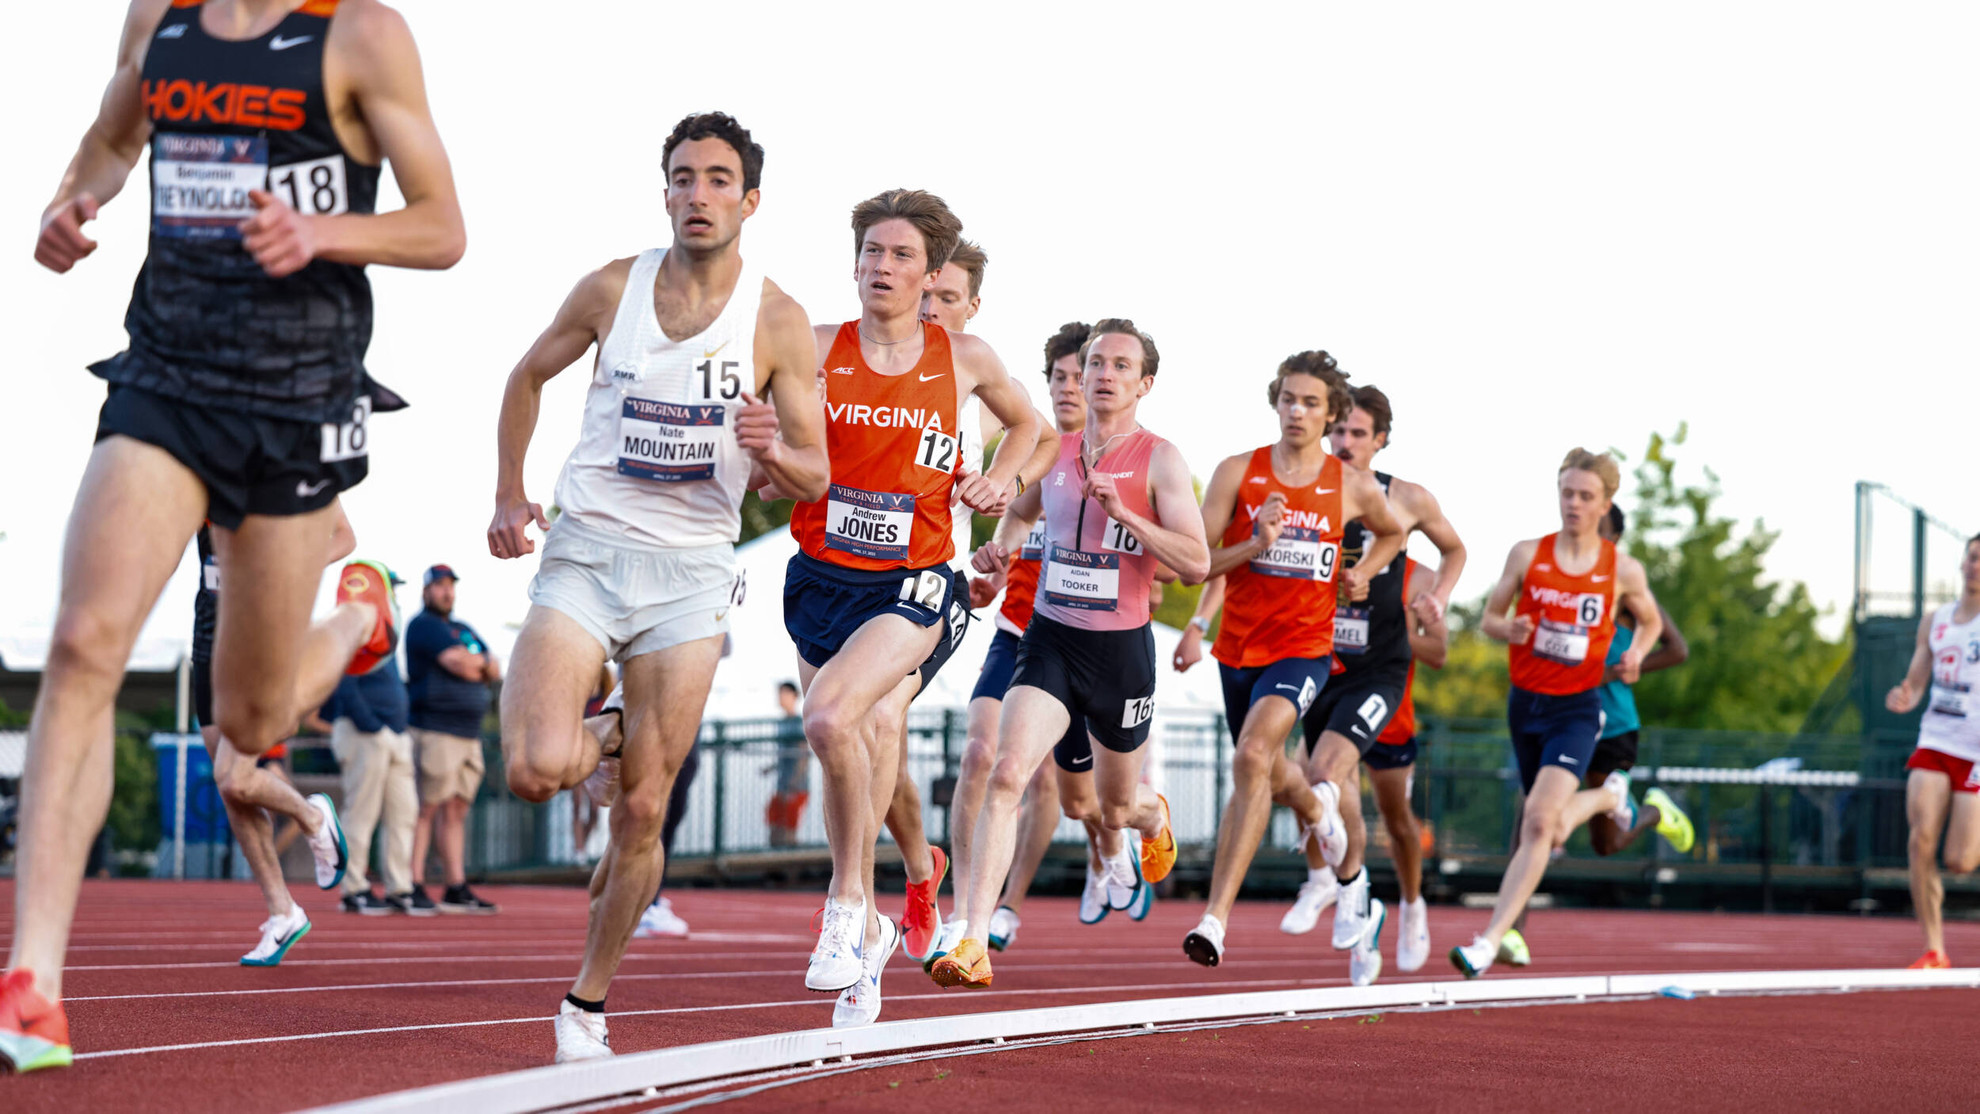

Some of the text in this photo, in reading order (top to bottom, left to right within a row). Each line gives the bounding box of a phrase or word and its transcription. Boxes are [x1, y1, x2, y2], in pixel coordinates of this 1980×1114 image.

[141, 78, 307, 131] HOKIES
[279, 164, 336, 214] 18
[697, 359, 741, 400] 15
[831, 366, 855, 376] ACC
[632, 400, 691, 419] VIRGINIA
[826, 402, 943, 432] VIRGINIA
[659, 425, 685, 439] Nate
[624, 435, 715, 460] MOUNTAIN
[923, 432, 954, 472] 12
[837, 486, 884, 504] VIRGINIA
[852, 506, 887, 522] Andrew
[837, 516, 898, 543] JONES
[1056, 548, 1092, 563] VIRGINIA
[1319, 546, 1335, 578] 9
[1061, 578, 1099, 592] TOOKER
[1070, 568, 1090, 577] AIDAN
[908, 574, 942, 610] 12
[1581, 597, 1597, 623] 6
[1132, 694, 1151, 724] 16
